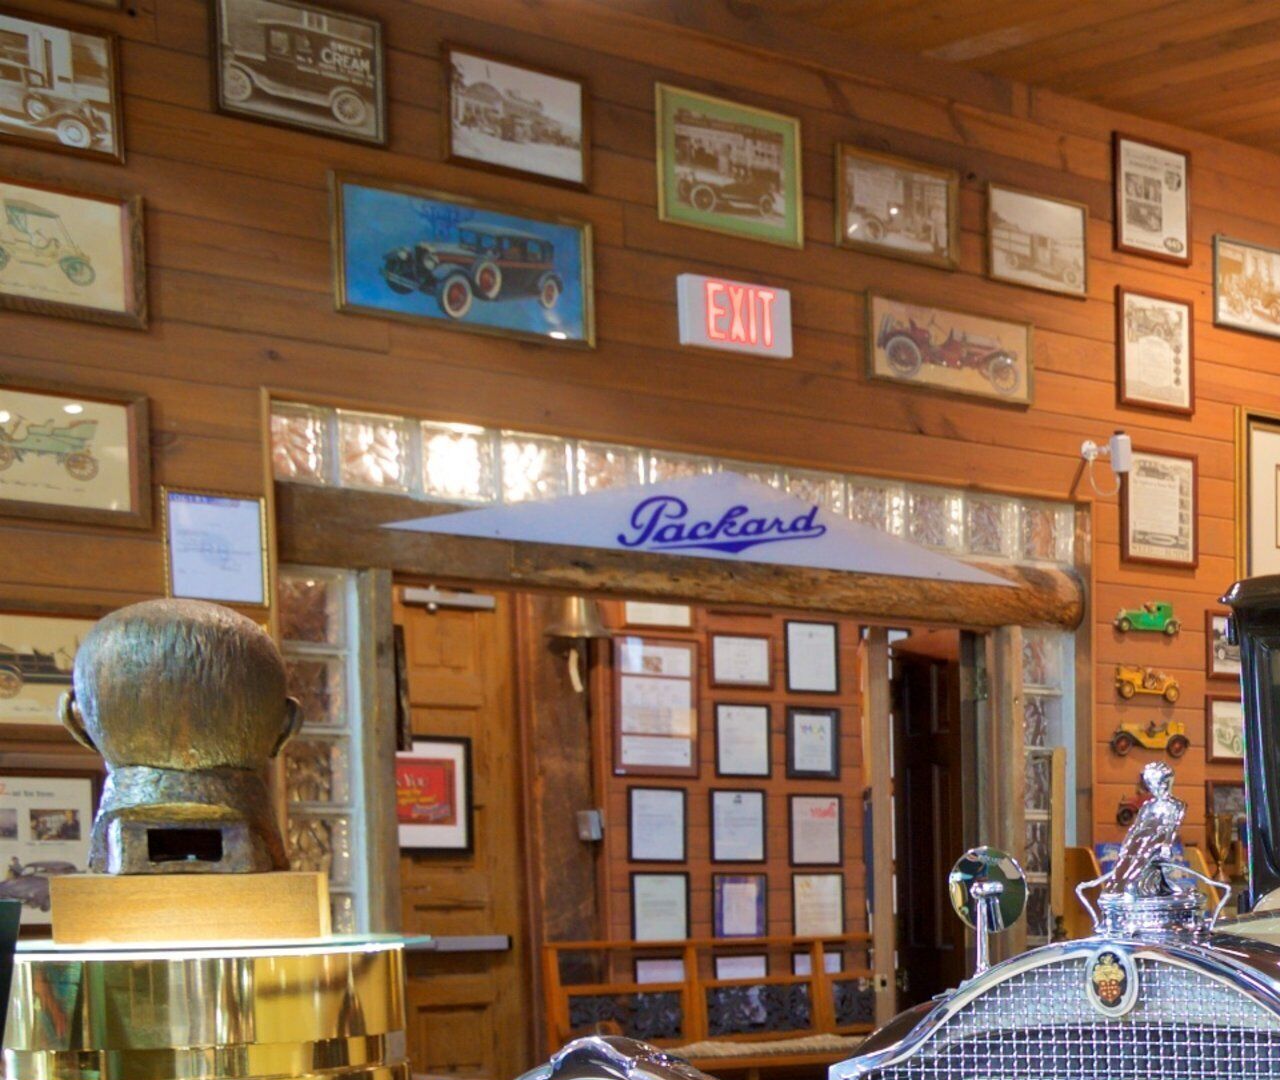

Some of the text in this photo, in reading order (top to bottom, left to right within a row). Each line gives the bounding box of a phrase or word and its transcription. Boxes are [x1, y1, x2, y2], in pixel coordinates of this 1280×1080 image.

[320, 47, 370, 73] CREAM
[704, 278, 776, 348] EXIT
[616, 494, 827, 554] Packard
